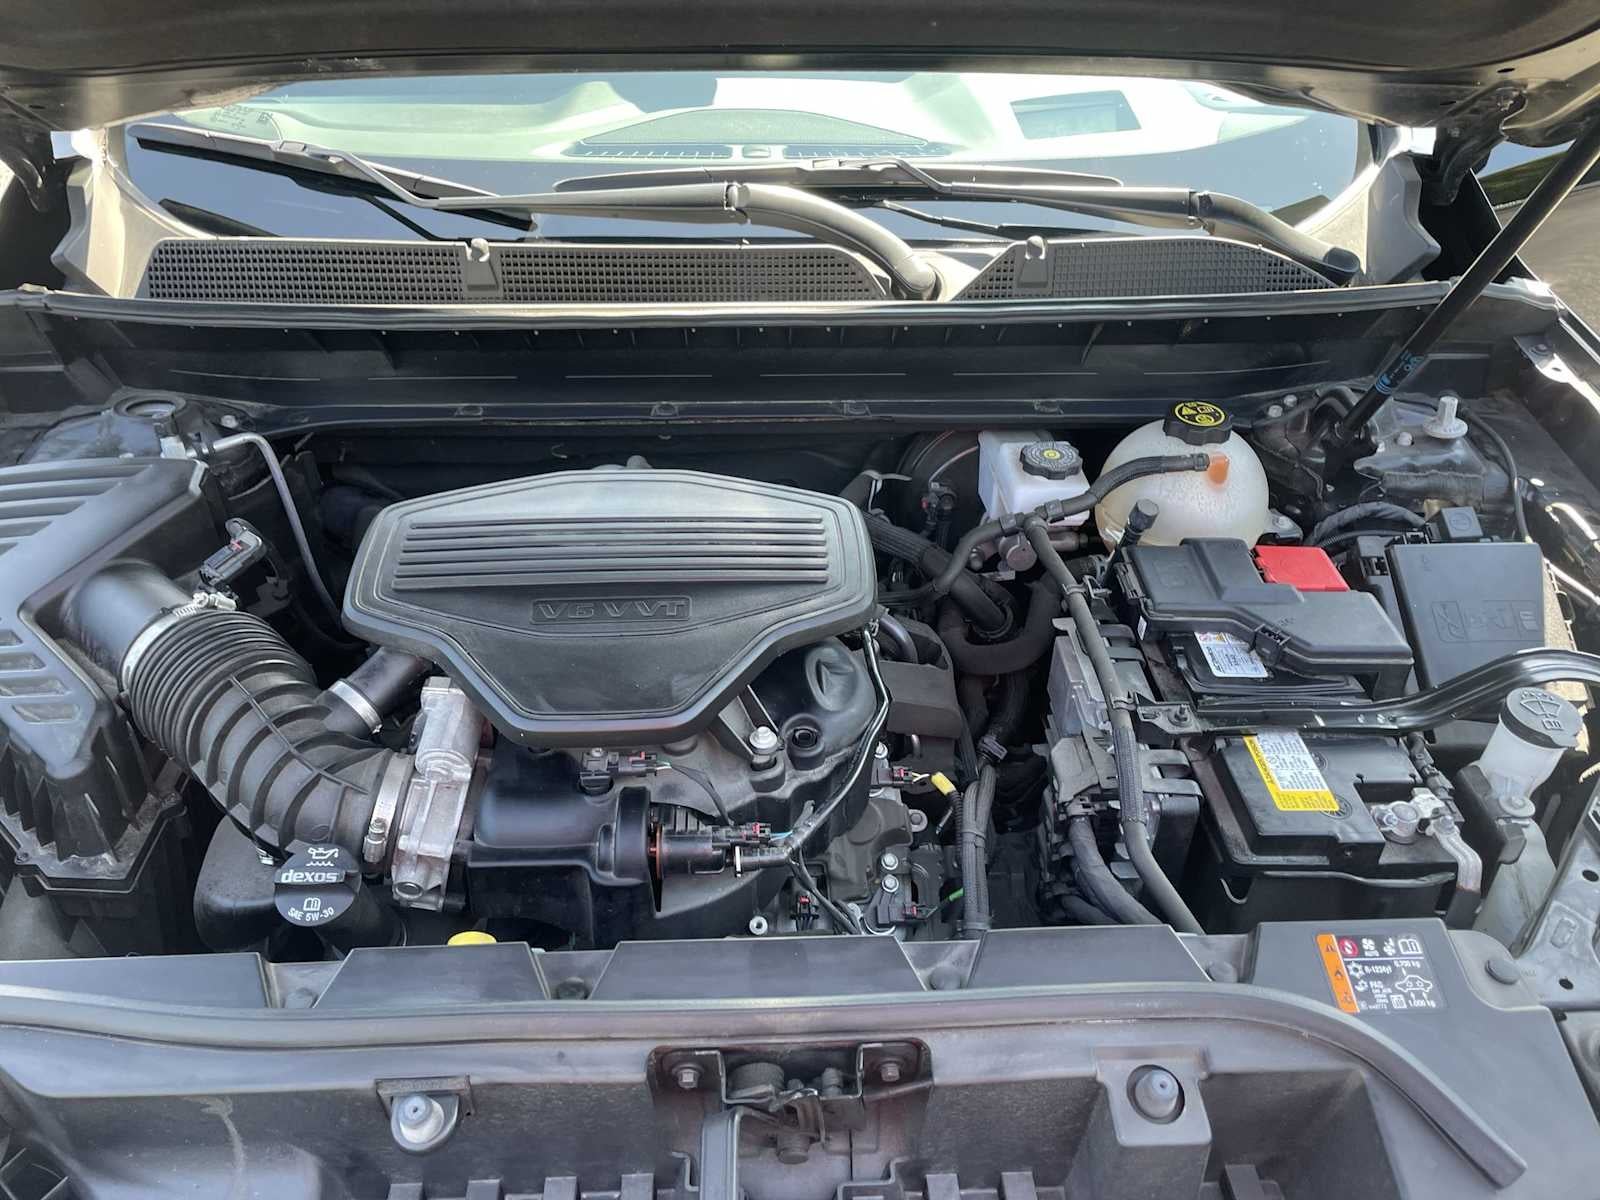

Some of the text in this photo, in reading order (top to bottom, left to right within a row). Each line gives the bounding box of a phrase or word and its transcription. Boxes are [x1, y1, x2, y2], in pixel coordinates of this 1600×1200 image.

[537, 600, 686, 619] V6 VVT
[281, 869, 339, 883] dexos
[287, 906, 335, 922] SAE 5W-30
